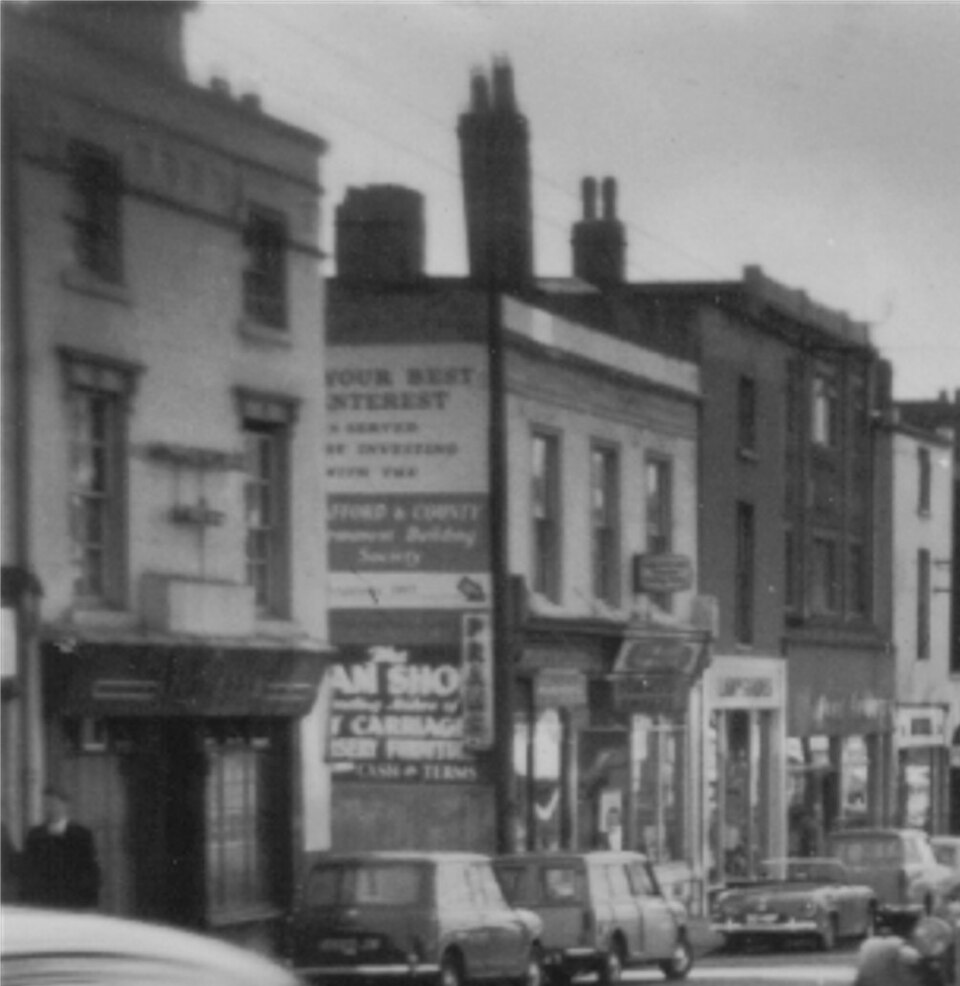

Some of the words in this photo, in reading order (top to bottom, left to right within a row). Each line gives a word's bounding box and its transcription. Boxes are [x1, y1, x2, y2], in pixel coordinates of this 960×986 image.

[325, 368, 392, 387] YOUR
[406, 367, 474, 386] BEST
[326, 391, 449, 411] NTEREST
[346, 422, 418, 433] SERVED
[357, 442, 458, 455] INVESTING
[381, 466, 418, 477] THE
